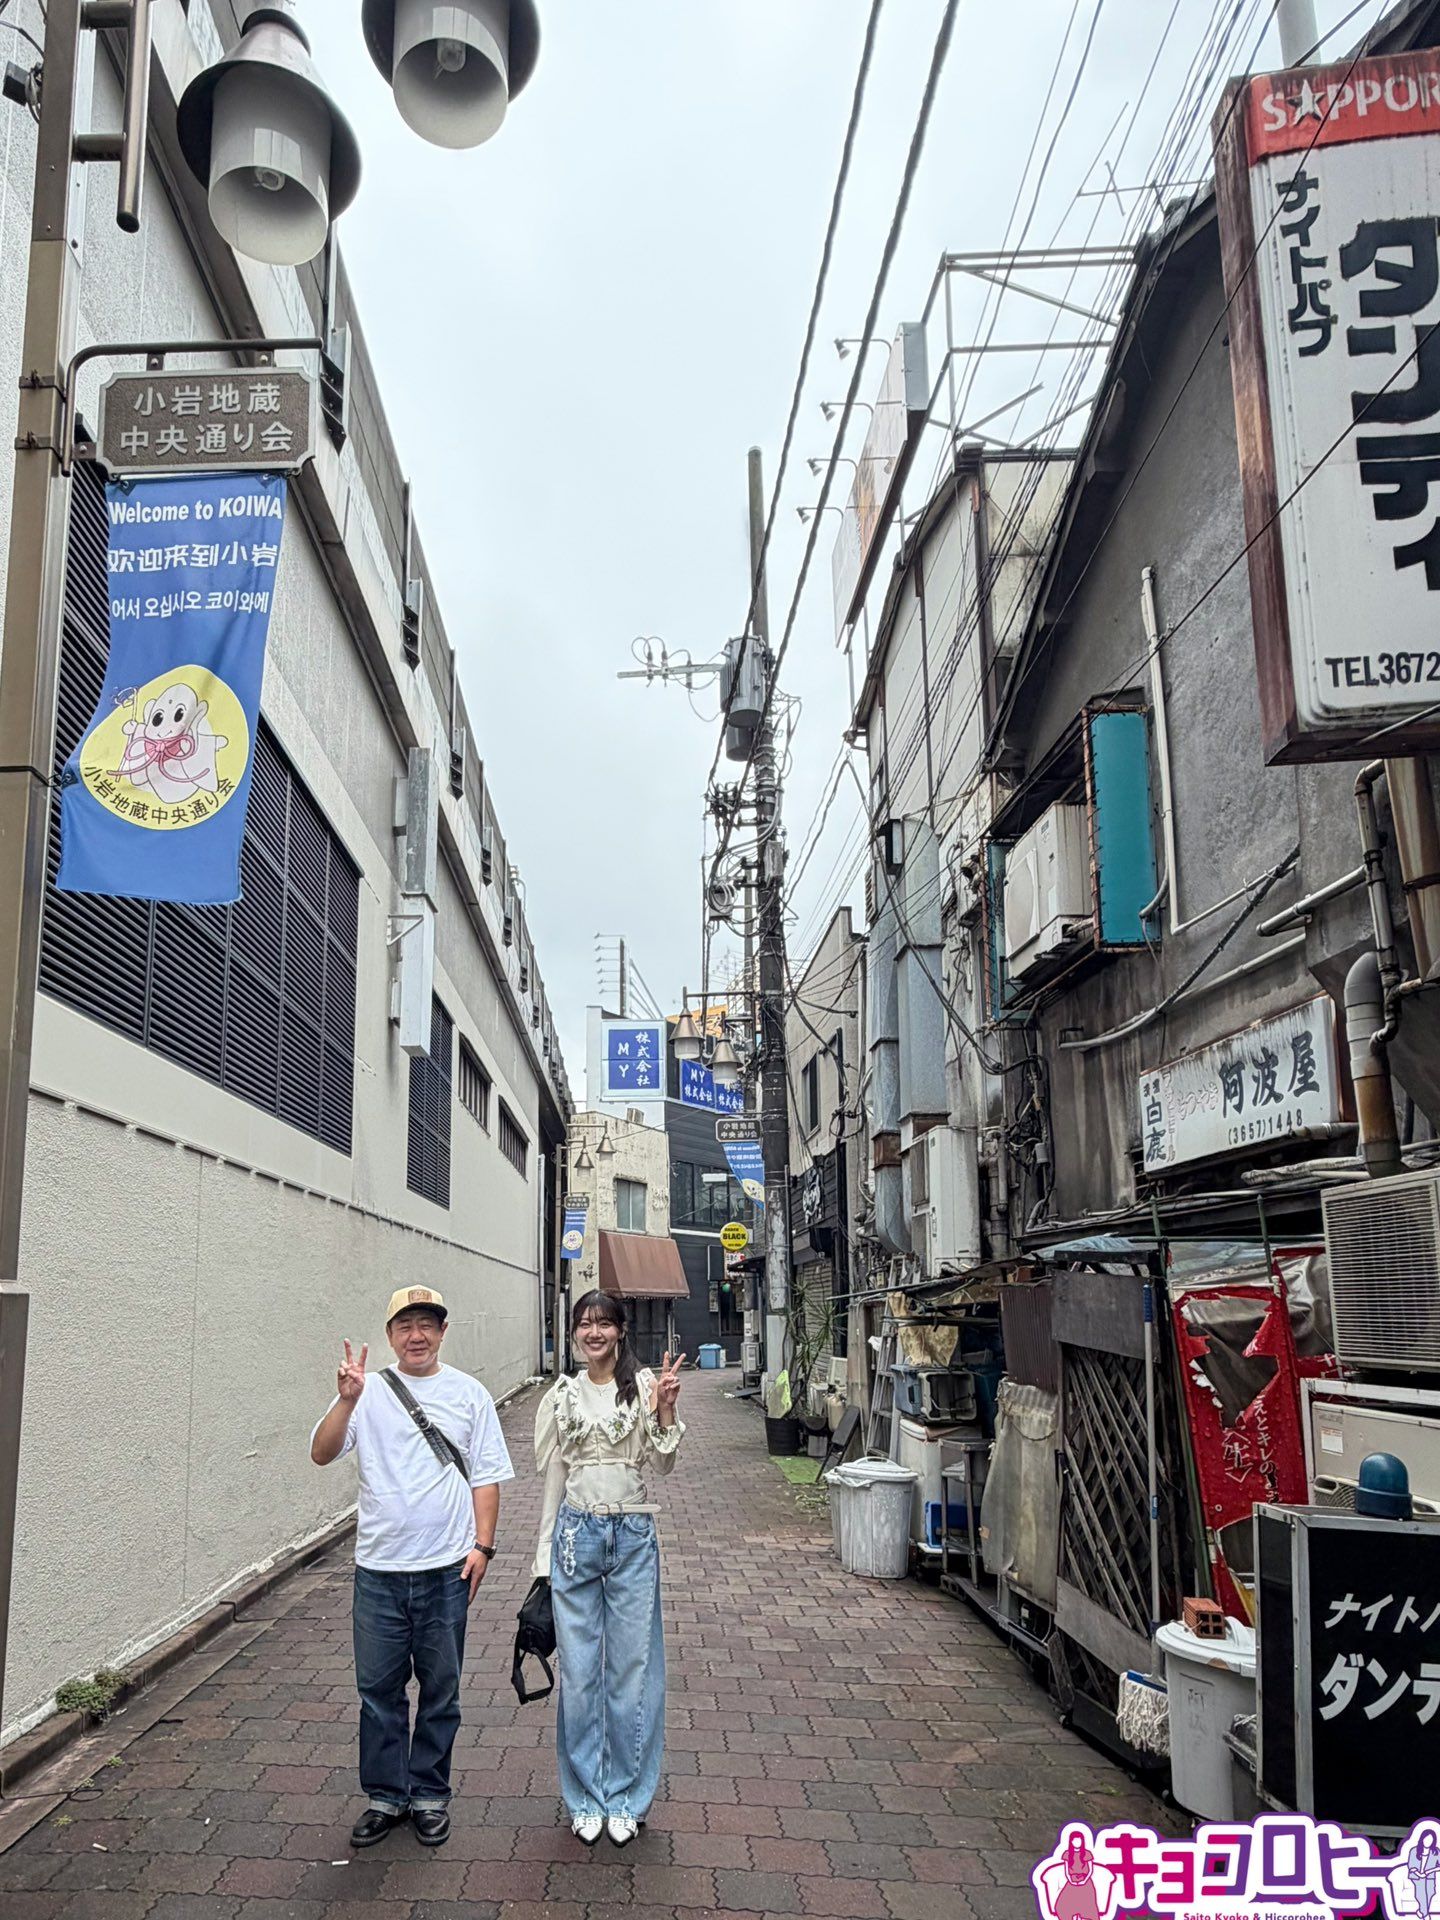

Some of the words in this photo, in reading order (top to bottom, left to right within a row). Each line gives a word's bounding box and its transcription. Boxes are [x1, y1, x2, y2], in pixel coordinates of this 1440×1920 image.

[133, 382, 281, 416] 小岩地蔵
[120, 420, 294, 457] 中央通り会
[108, 501, 189, 525] Welcome
[195, 500, 213, 520] to
[218, 495, 282, 520] KOIWA
[108, 541, 278, 572] 欢迎来到小岩
[111, 597, 140, 621] 어서
[143, 590, 202, 618] 오십시오
[205, 590, 269, 614] 코이와에
[85, 766, 235, 825] 小岩地蔵中央通り会
[635, 1031, 652, 1087] 株式会社
[1218, 1030, 1320, 1119] 阿波屋
[690, 1068, 706, 1084] MY
[684, 1083, 713, 1103] 株式会社
[1228, 1108, 1303, 1146] (3657)1448
[722, 1232, 747, 1241] BLACK
